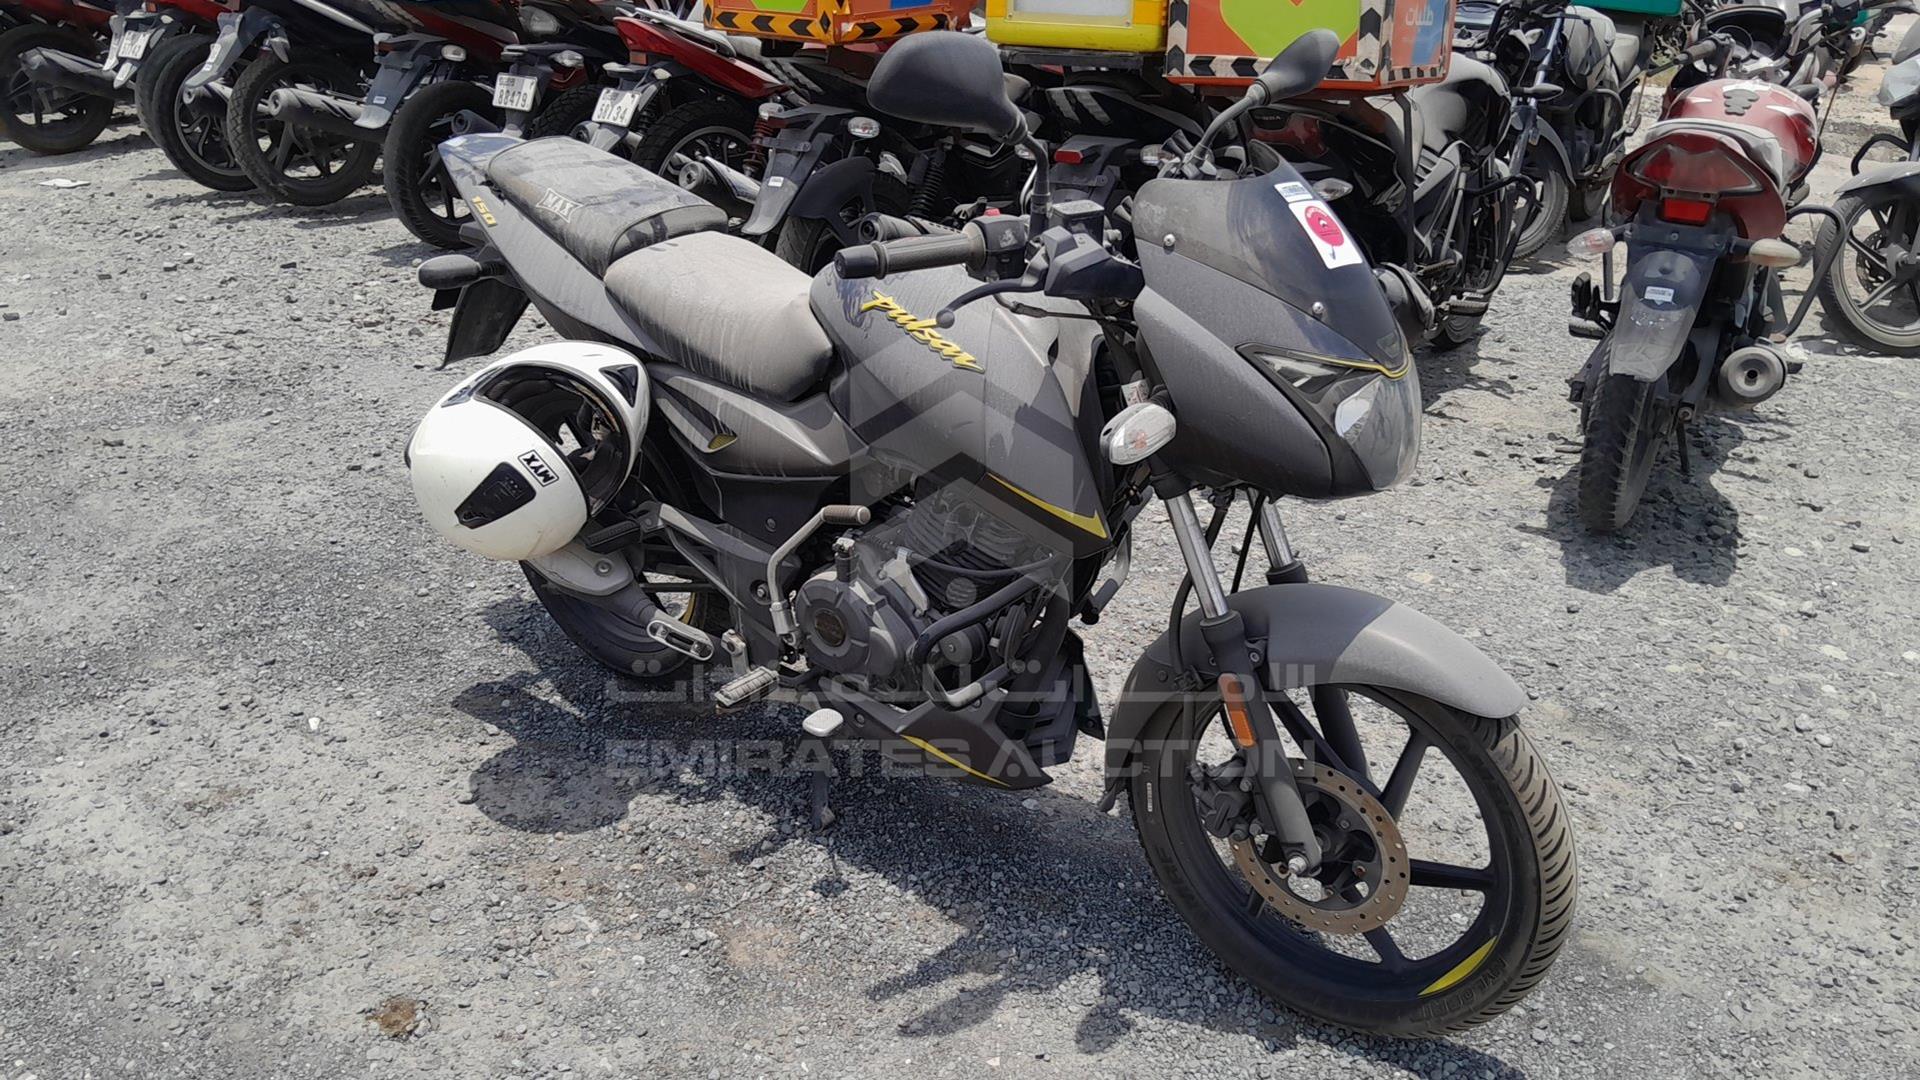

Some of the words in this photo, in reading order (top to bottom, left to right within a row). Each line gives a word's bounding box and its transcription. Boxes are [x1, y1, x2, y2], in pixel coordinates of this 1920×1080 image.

[472, 196, 498, 226] 150
[542, 193, 574, 216] MAX
[522, 454, 556, 483] MYX
